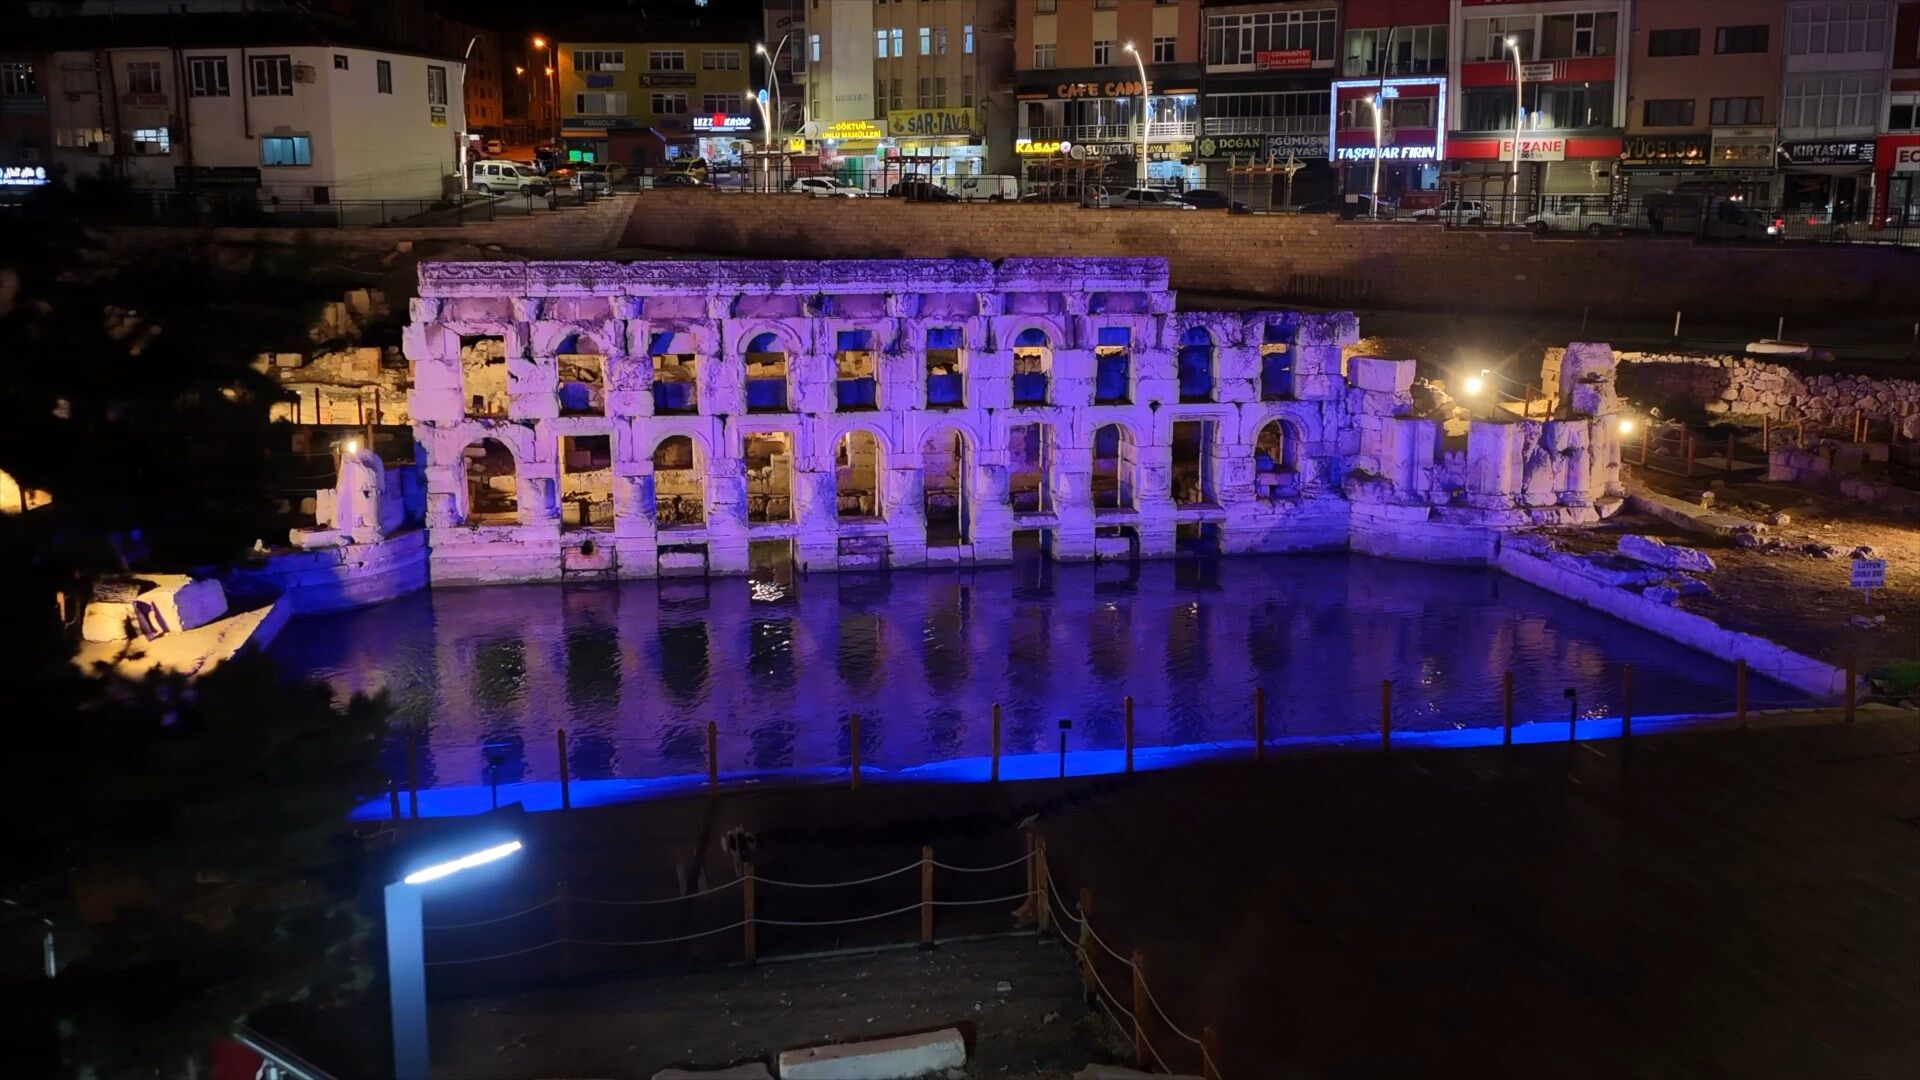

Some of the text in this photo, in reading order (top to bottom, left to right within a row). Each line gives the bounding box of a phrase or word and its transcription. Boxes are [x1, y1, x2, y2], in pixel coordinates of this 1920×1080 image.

[1057, 84, 1099, 98] CAFE
[1016, 142, 1060, 153] KASAP
[1220, 138, 1260, 148] DOĞAN
[1503, 141, 1561, 152] ECZANE
[1338, 147, 1435, 161] TAŞPINAR FIRIN
[1793, 143, 1857, 156] KIRTASİYE
